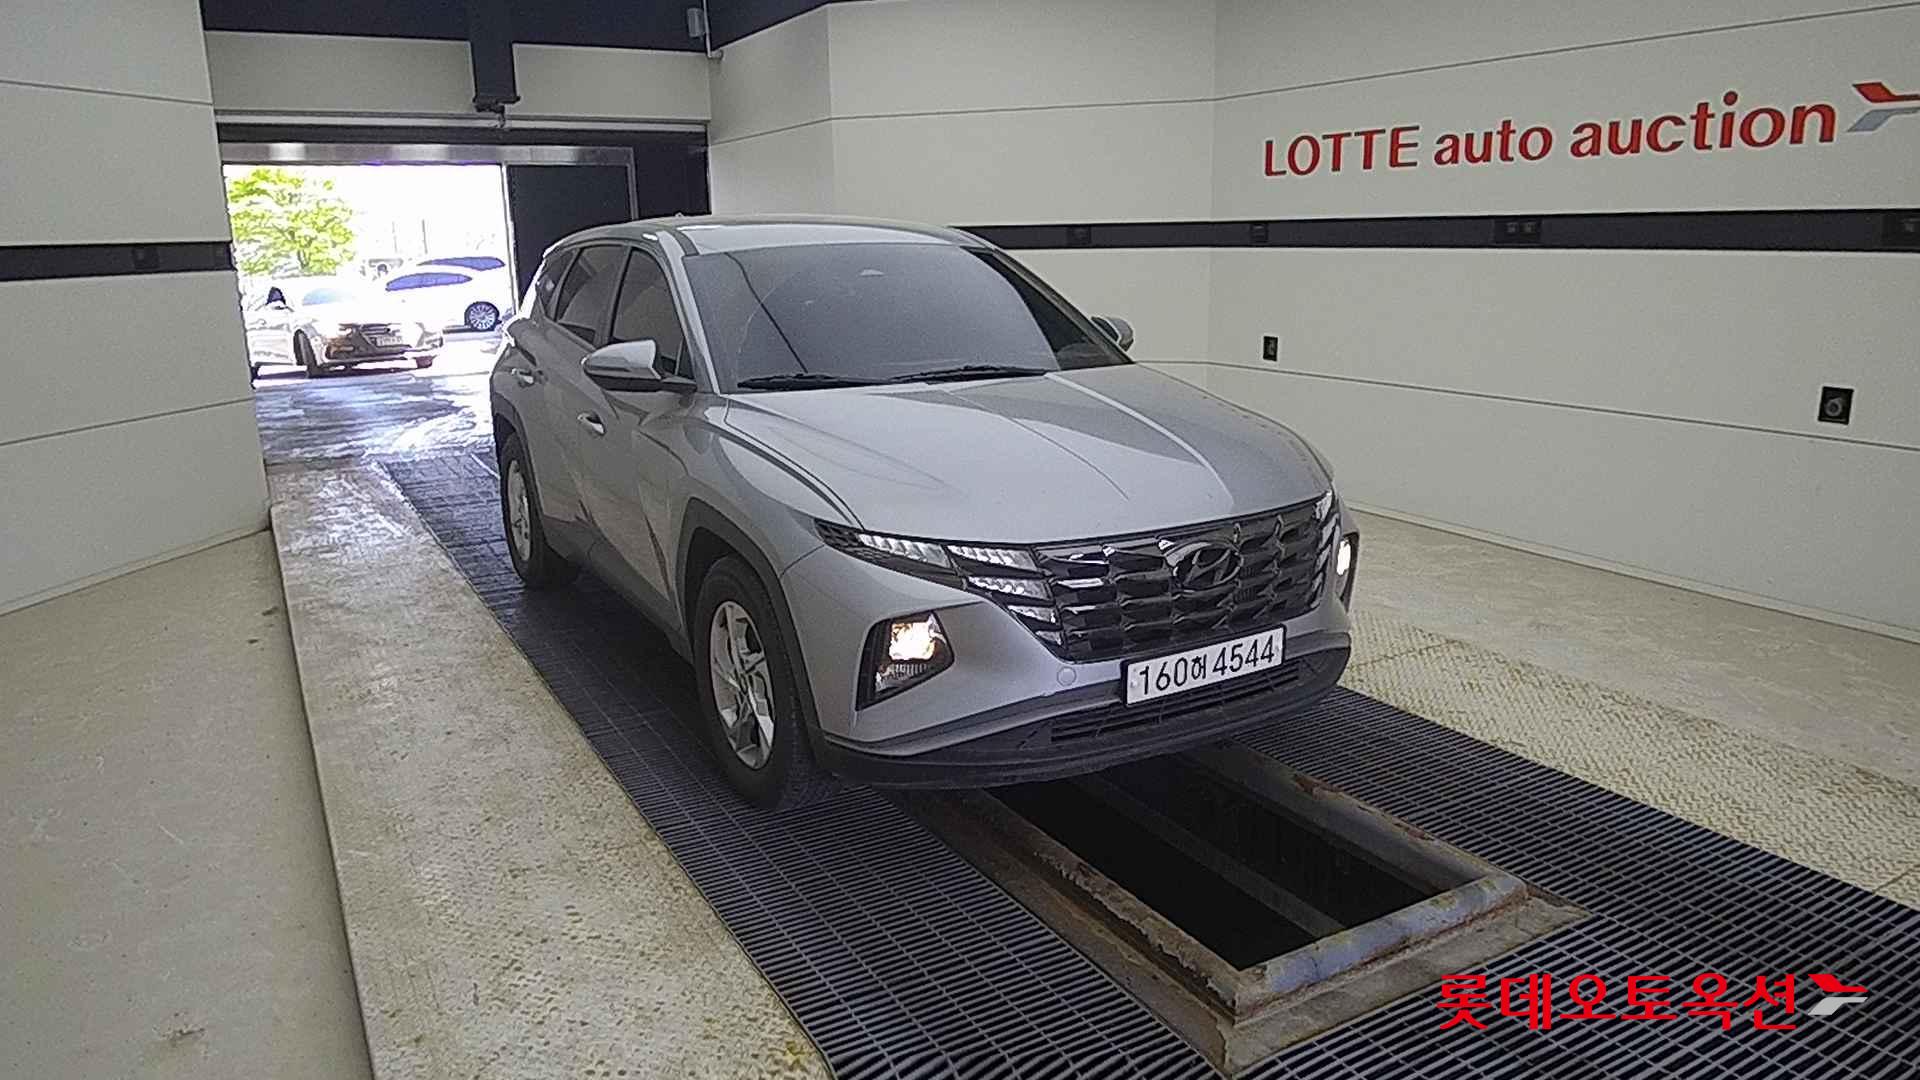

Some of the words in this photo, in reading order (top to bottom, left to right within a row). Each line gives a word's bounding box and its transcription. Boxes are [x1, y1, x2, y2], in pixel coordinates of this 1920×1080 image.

[1264, 125, 1420, 177] LOTTE
[1434, 119, 1553, 166] auto
[1569, 90, 1837, 159] auction
[1213, 634, 1275, 677] 4544
